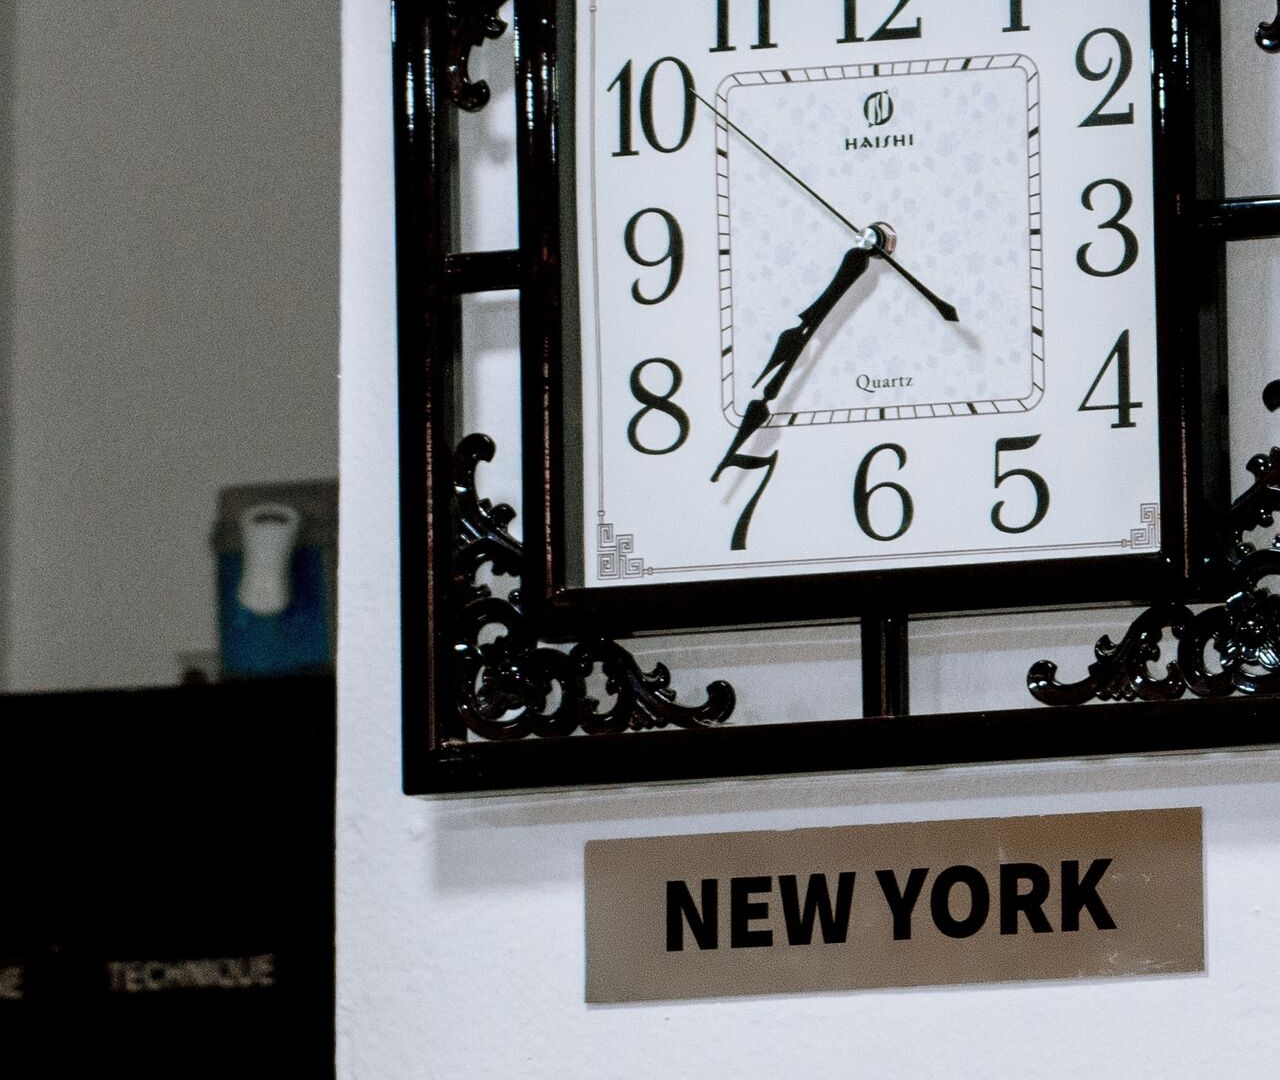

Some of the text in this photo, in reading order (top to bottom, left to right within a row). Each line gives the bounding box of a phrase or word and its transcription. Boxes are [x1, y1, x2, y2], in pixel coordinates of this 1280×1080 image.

[606, 56, 697, 157] 10
[1076, 28, 1133, 127] 2
[845, 134, 913, 150] HAISHI
[624, 208, 683, 305] 9
[1077, 179, 1138, 277] 3
[627, 358, 689, 455] 8
[856, 374, 913, 393] Quartz
[1078, 330, 1142, 428] 4
[711, 449, 778, 551] 7
[854, 443, 913, 541] 6
[991, 435, 1049, 533] 5
[666, 858, 1117, 952] NEW YORK
[108, 954, 275, 992] TECHNIQUE
